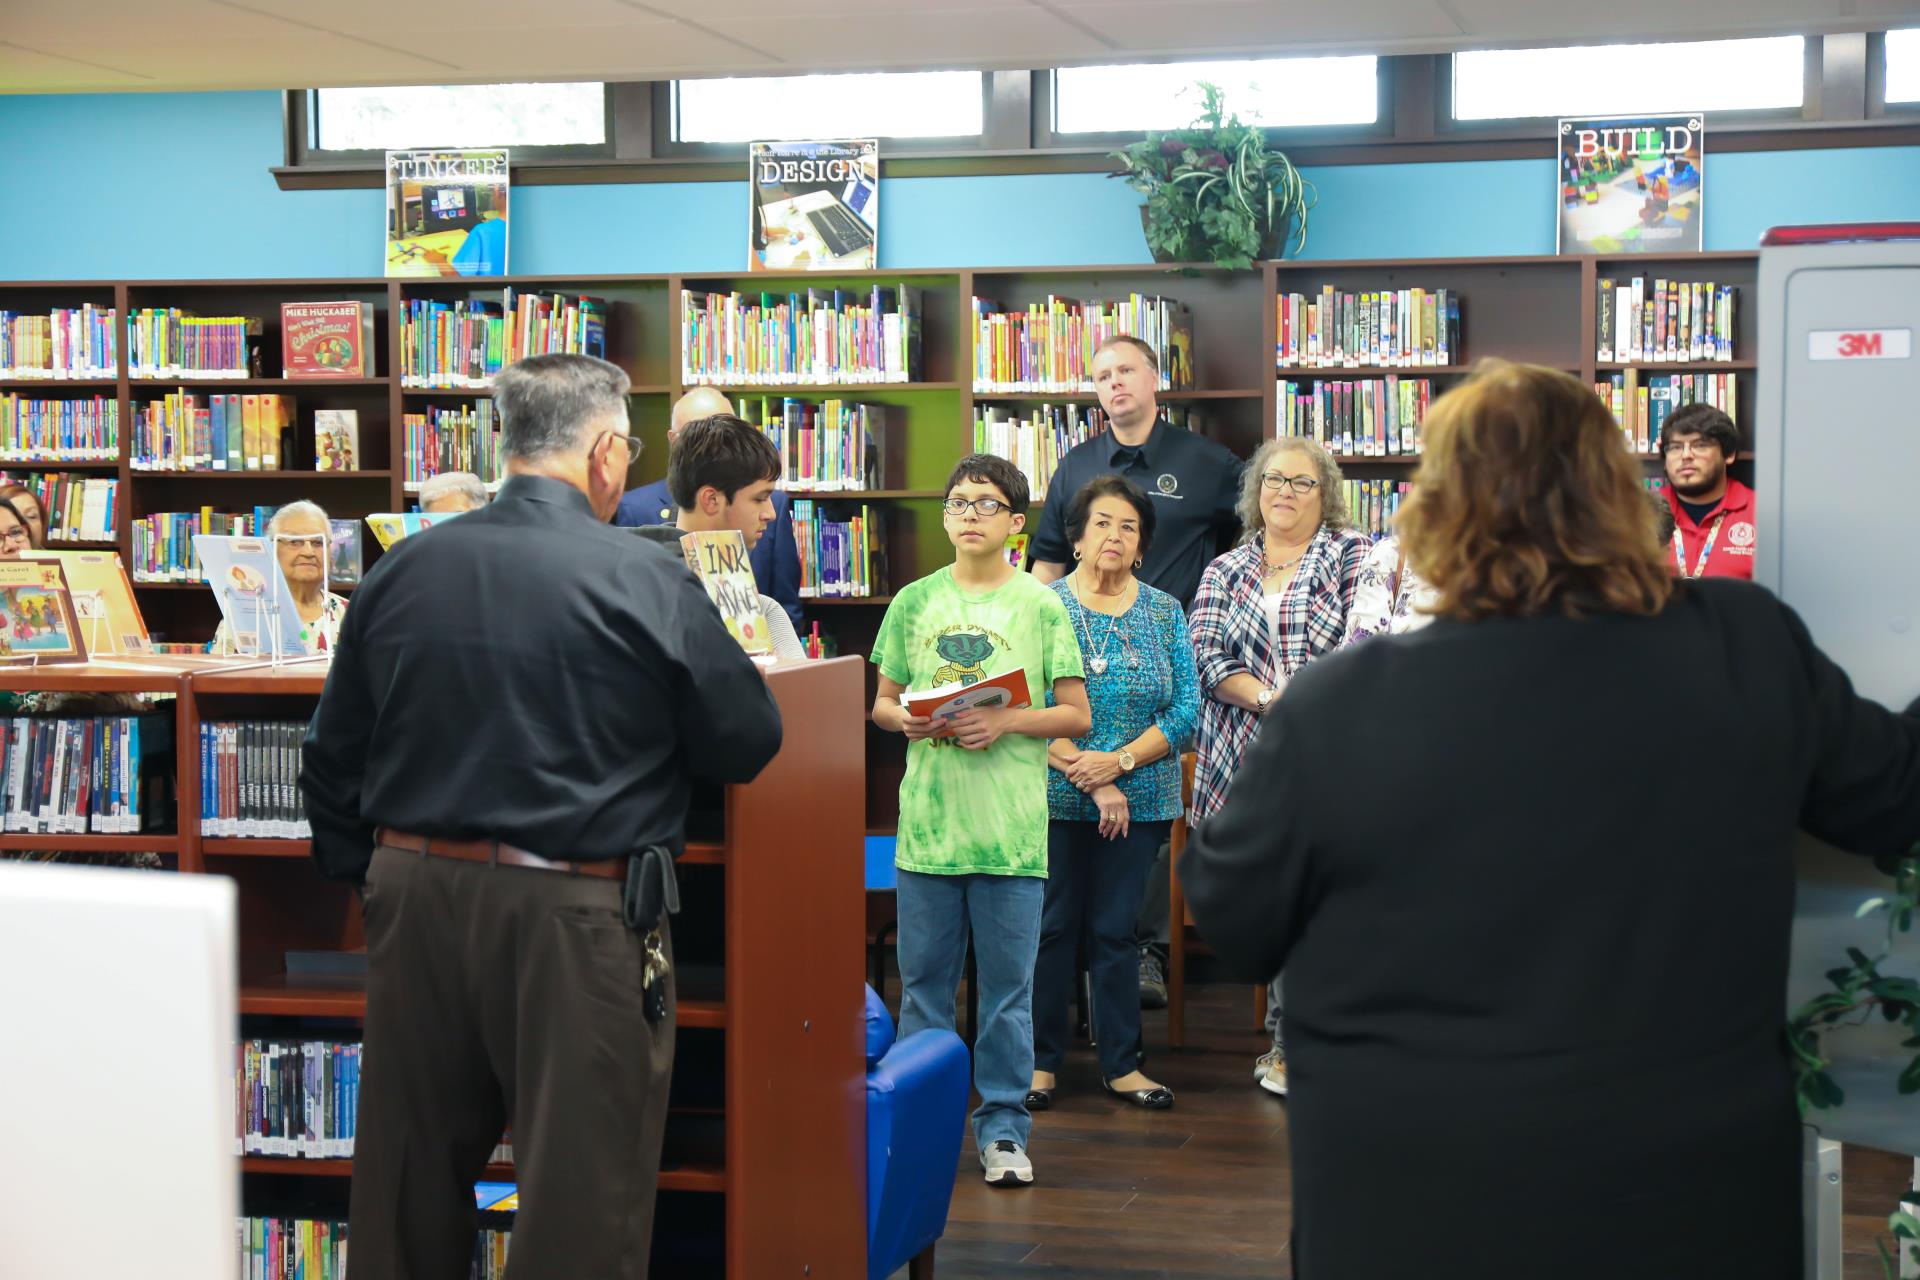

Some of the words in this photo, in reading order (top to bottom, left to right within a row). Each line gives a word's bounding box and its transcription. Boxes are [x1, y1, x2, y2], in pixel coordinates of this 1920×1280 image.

[830, 147, 858, 156] Library
[1575, 126, 1693, 158] BUILD
[397, 157, 504, 180] TINKER
[760, 159, 866, 183] DESIGN
[285, 308, 308, 317] MIKE
[309, 307, 357, 317] HUCKABEE
[1838, 333, 1882, 357] 3M
[704, 541, 750, 575] INK
[287, 1253, 294, 1265] TO
